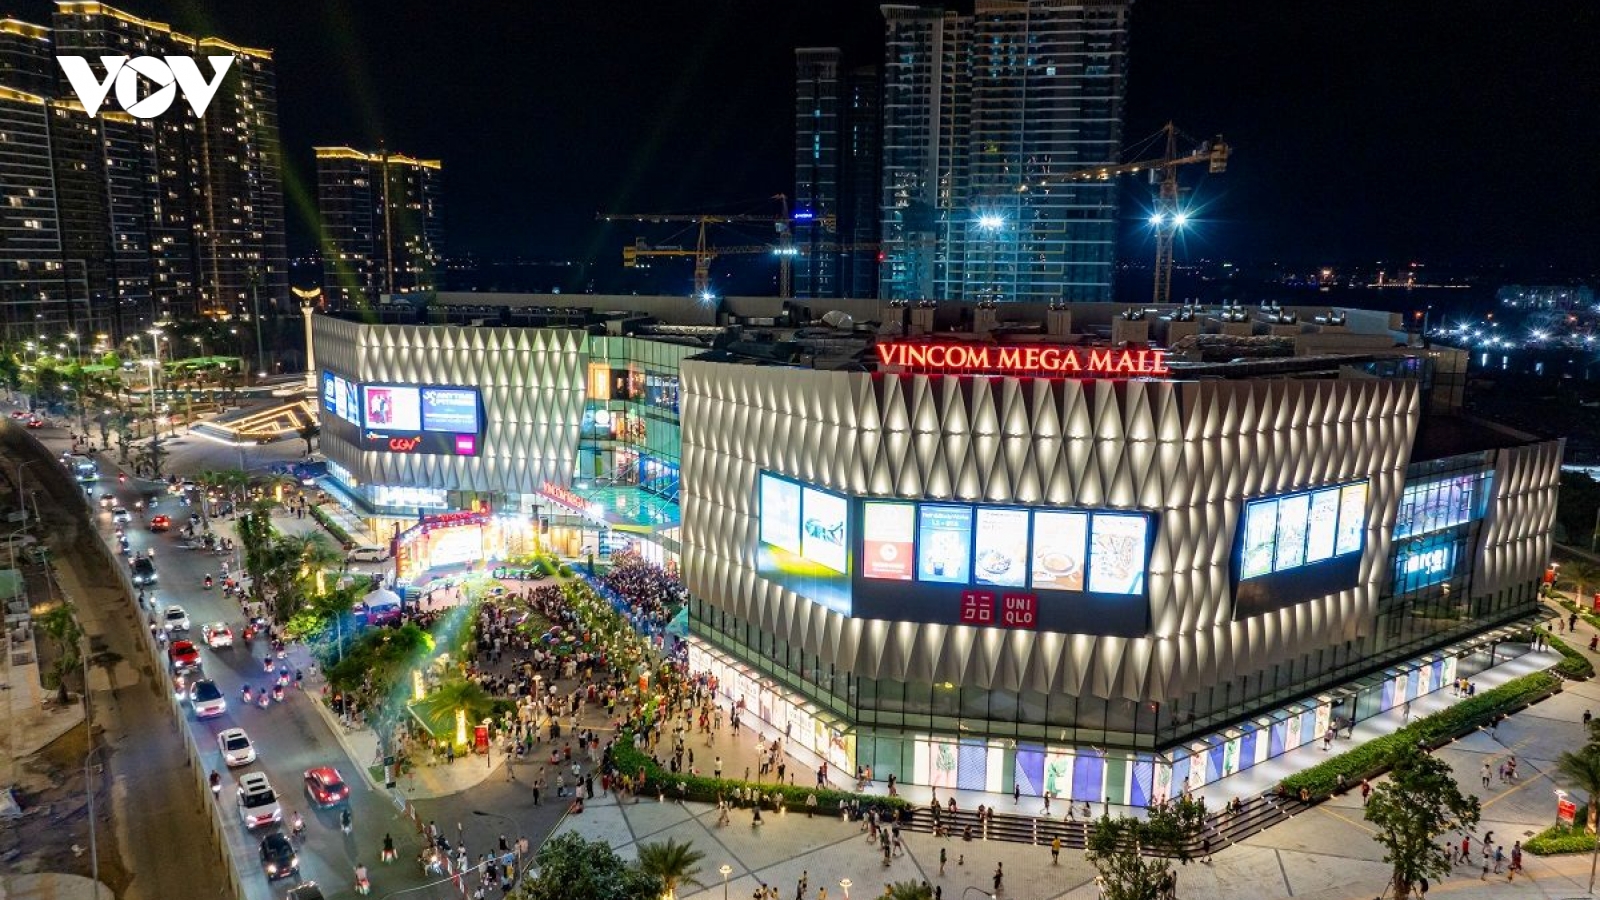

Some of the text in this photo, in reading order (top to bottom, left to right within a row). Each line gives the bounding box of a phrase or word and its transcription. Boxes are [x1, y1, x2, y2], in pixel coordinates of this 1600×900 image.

[877, 343, 1169, 373] VINCOM MEGA MALL
[389, 438, 416, 451] CGV
[1006, 598, 1030, 611] UNI
[1006, 611, 1033, 624] QLO
